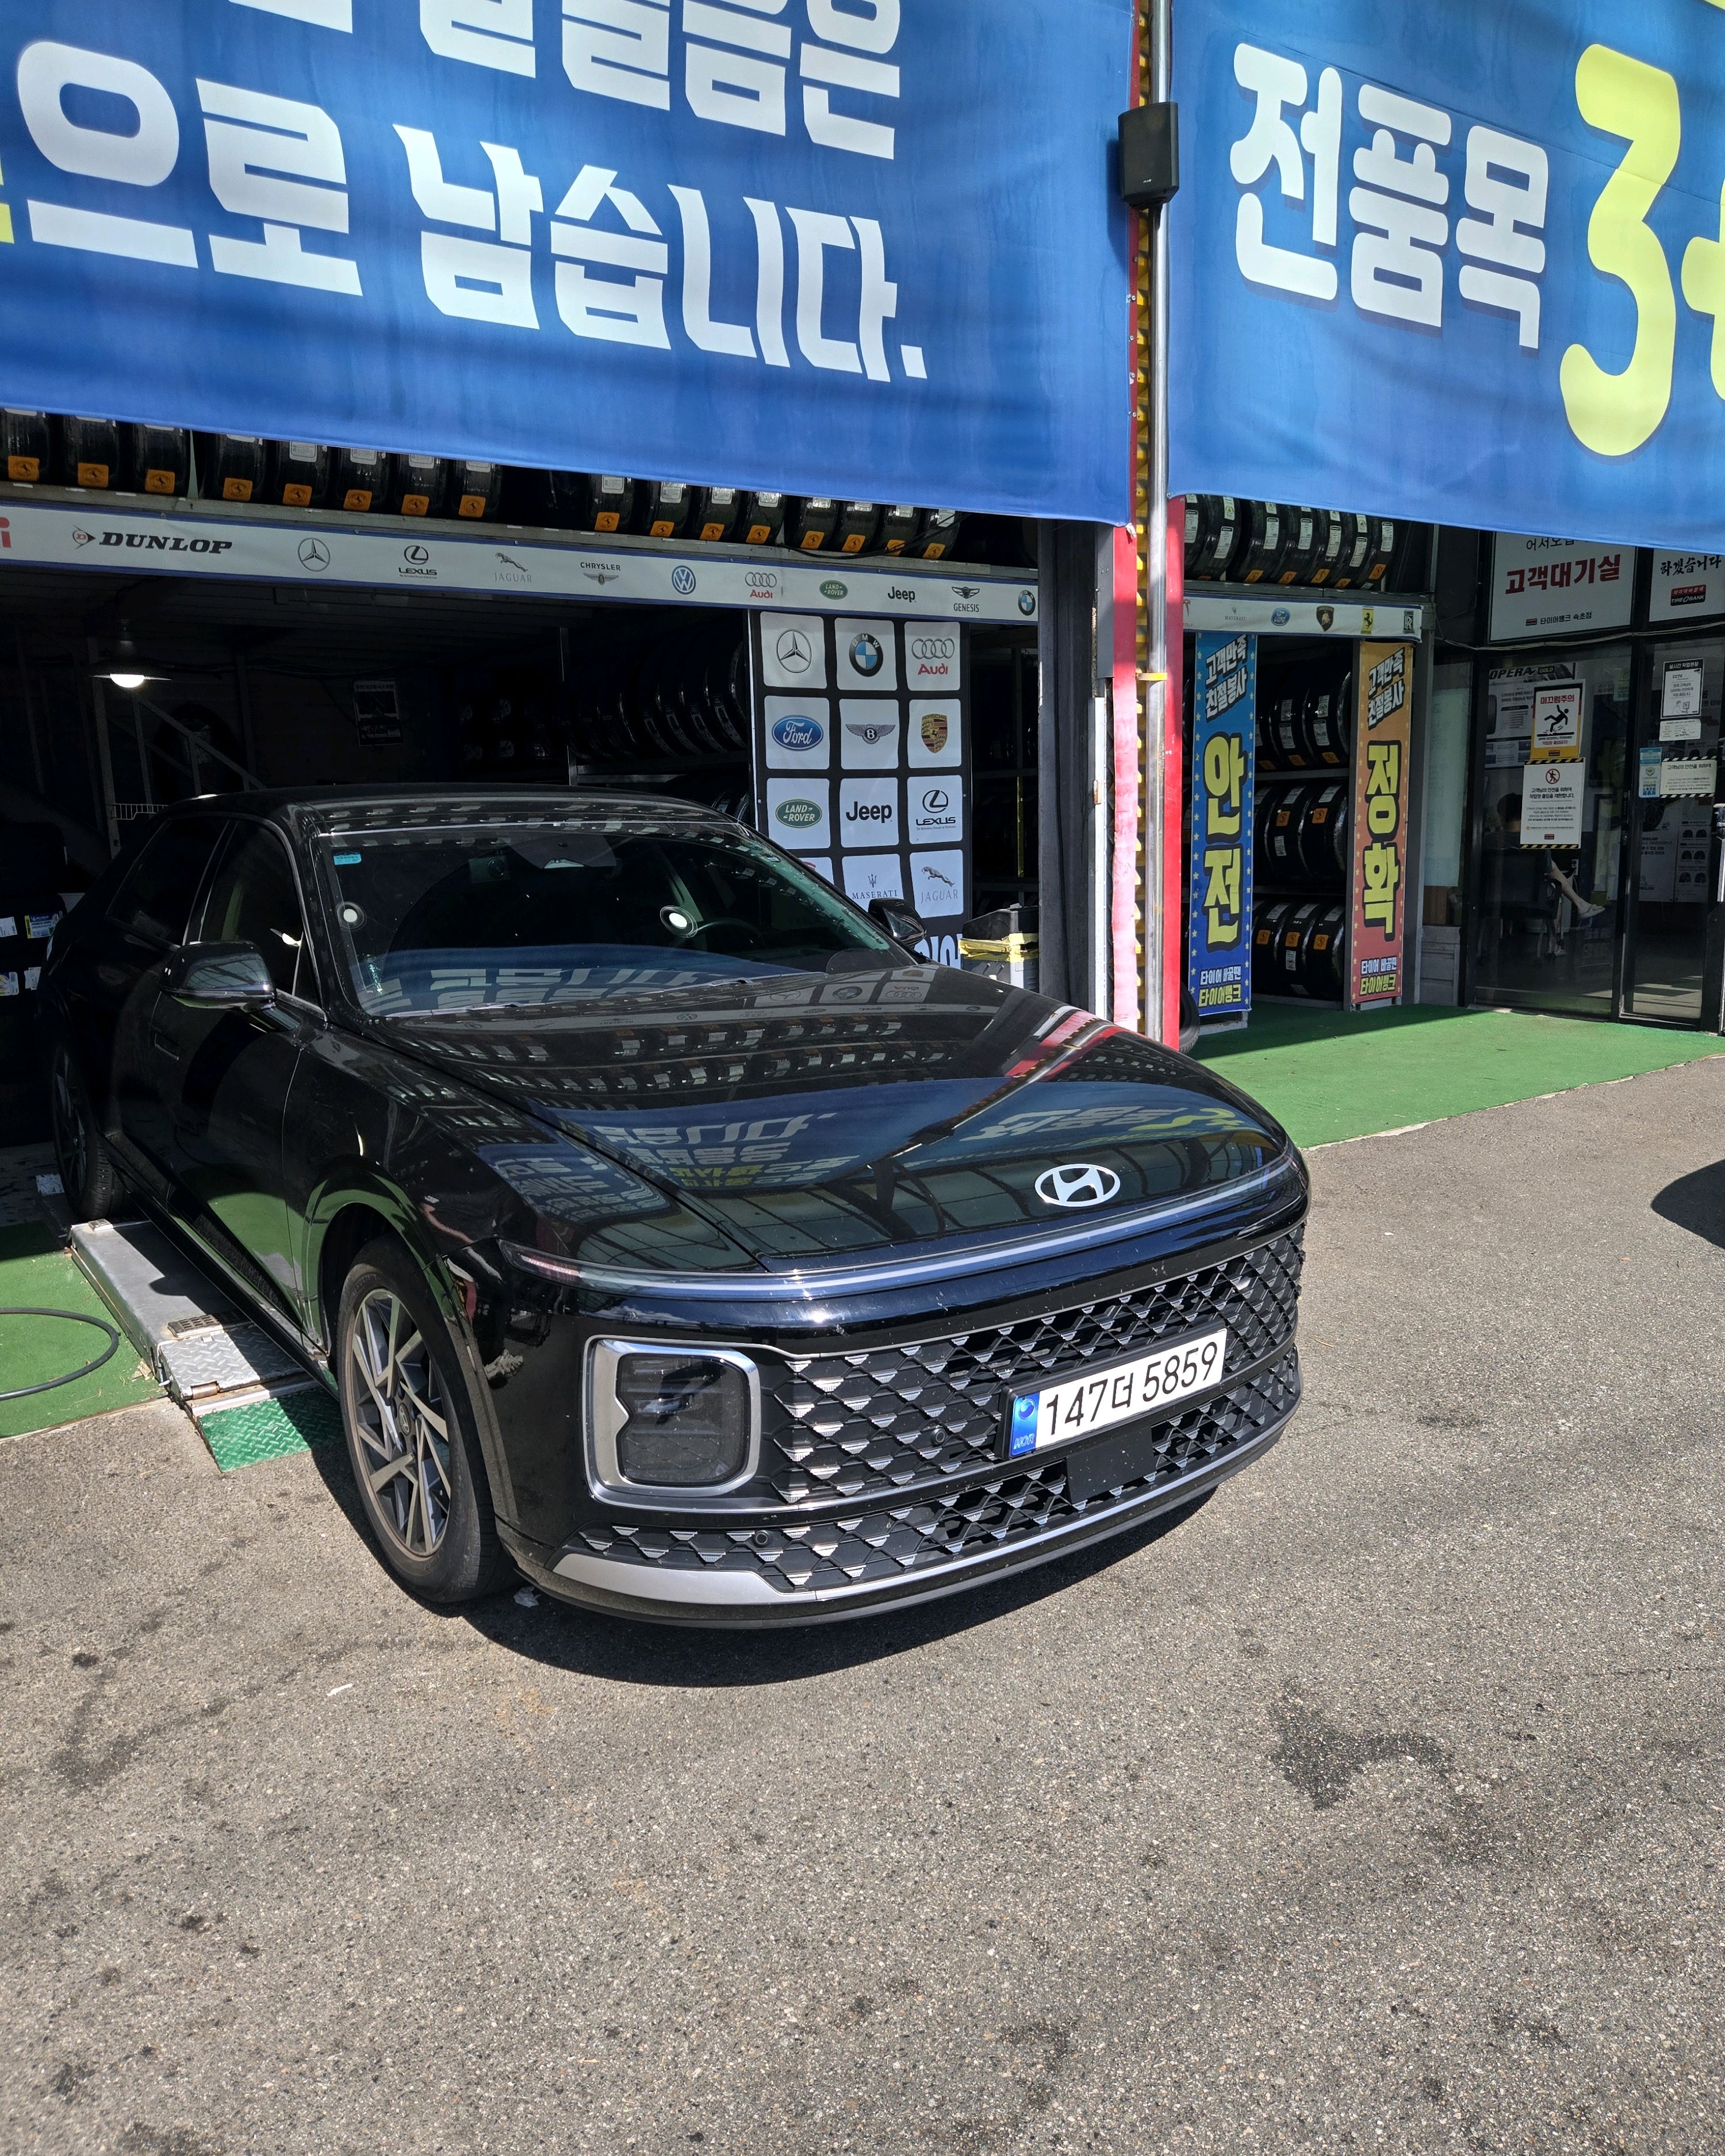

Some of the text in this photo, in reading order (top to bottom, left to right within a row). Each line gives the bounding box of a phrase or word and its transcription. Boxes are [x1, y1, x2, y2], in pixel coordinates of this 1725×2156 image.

[1230, 43, 1548, 349] 전품목
[0, 41, 927, 382] 으로 남습니다.
[99, 531, 232, 554] DUNLOP
[398, 567, 438, 576] LEXUS
[580, 562, 621, 571] CHRYSLER
[1505, 554, 1621, 594] 고객대기실
[1660, 555, 1722, 576] 하겠습니다
[494, 572, 532, 583] JAGUAR
[749, 589, 773, 599] Audi
[888, 586, 916, 603] Jeep
[953, 603, 979, 613] GENESIS
[1540, 614, 1571, 625] 타이어뱅크
[1573, 611, 1592, 620] 속초점
[852, 634, 880, 648] BMW
[1206, 634, 1247, 685] 고객만족
[918, 663, 948, 676] Audi
[1368, 648, 1405, 695] 고객만족
[1489, 666, 1533, 680] OPERA
[1206, 667, 1247, 719] 친절봉사
[1540, 695, 1574, 704] 미끄럼주의
[1368, 680, 1404, 728] 친절봉사
[783, 722, 812, 745] Ford
[846, 801, 892, 823] Jeep
[915, 816, 956, 826] LEXUS
[1205, 736, 1244, 945] 안전
[1364, 745, 1399, 934] 정확
[852, 889, 898, 900] MASERATI
[921, 888, 959, 904] JAGUAR
[1361, 958, 1379, 975] 타이어
[1200, 968, 1222, 985] 타이어
[1359, 974, 1397, 995] 타이어뱅크
[1198, 984, 1241, 1007] 타이어뱅크
[1046, 1341, 1218, 1436] 147더 5859
[1013, 1432, 1034, 1450] KOR
